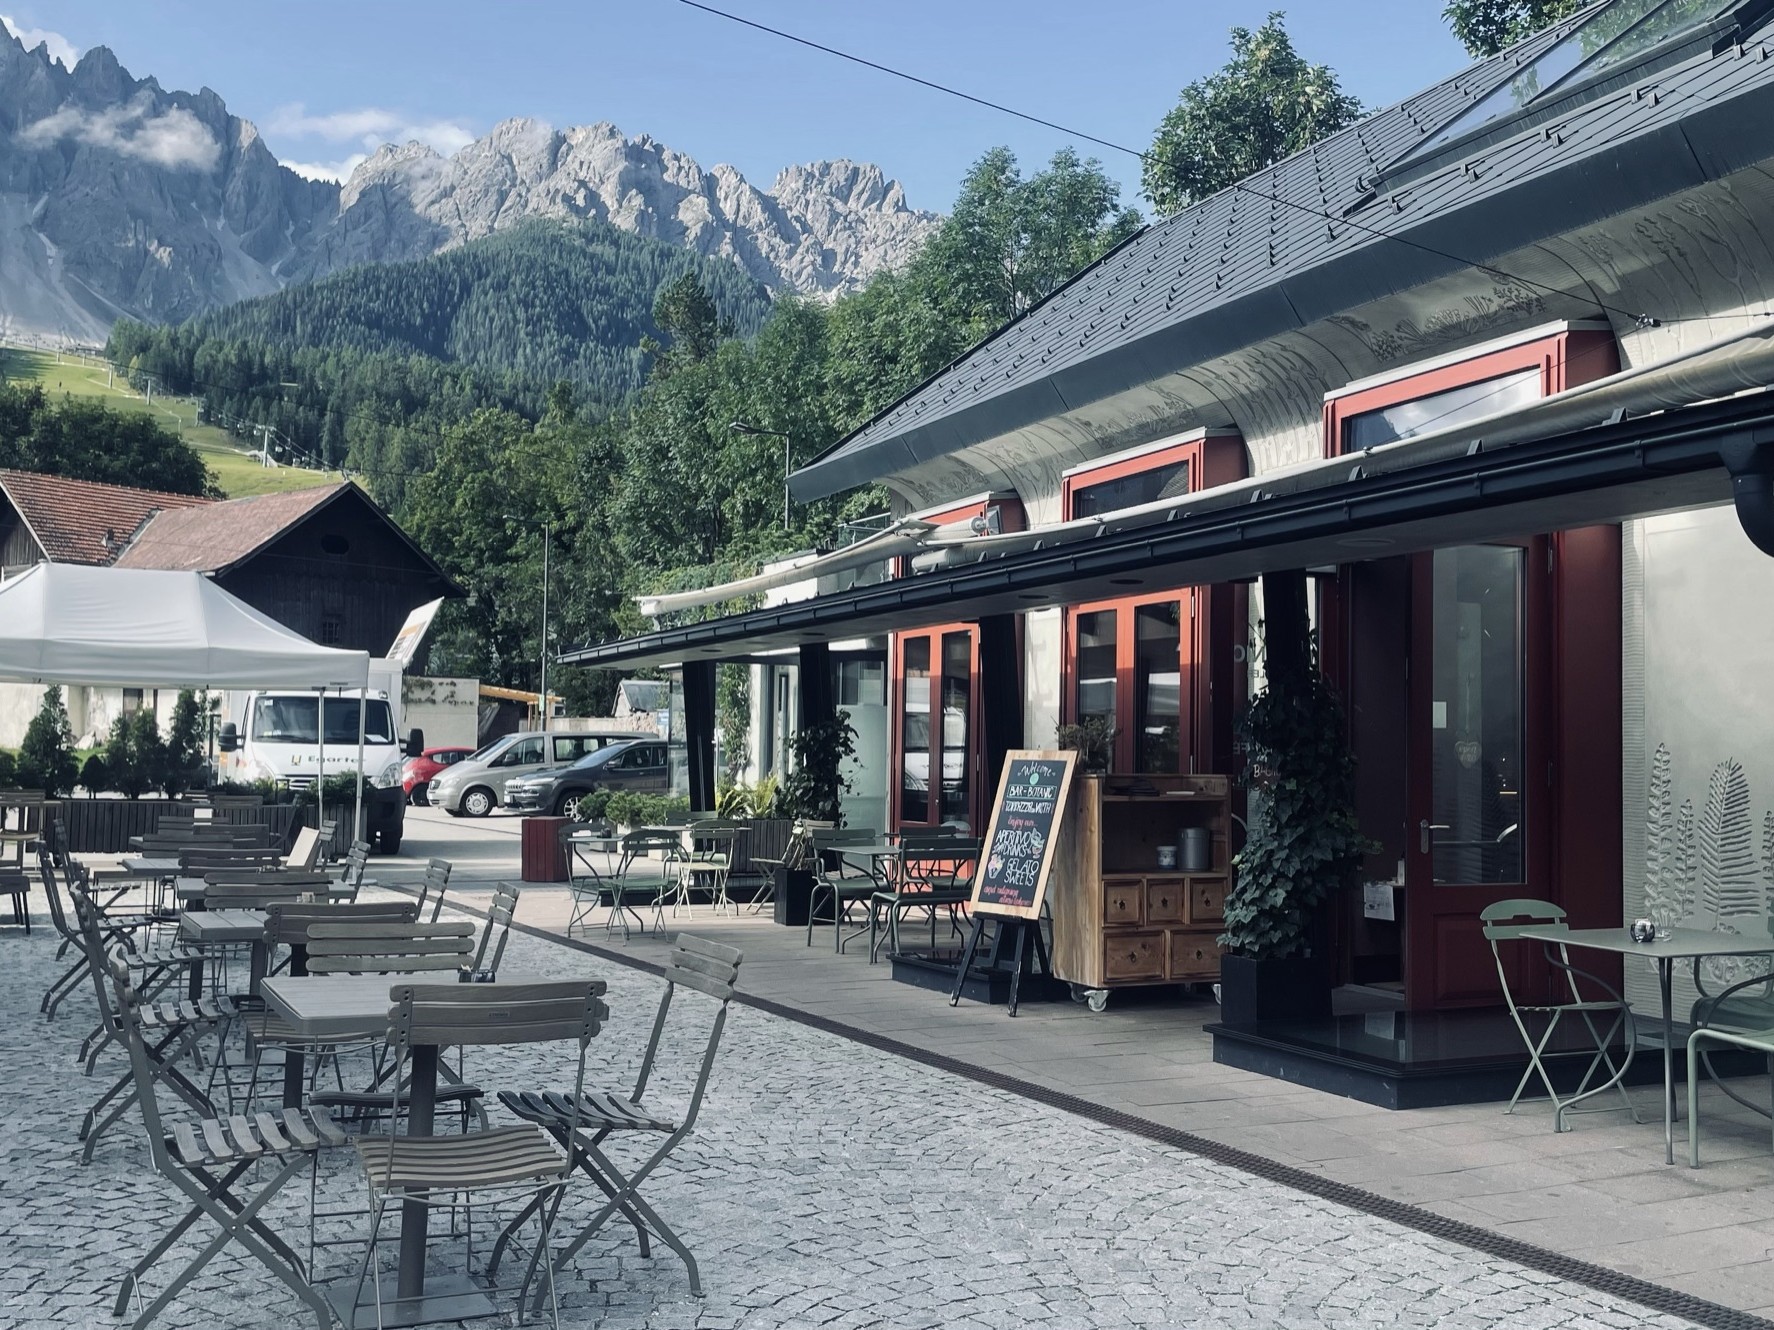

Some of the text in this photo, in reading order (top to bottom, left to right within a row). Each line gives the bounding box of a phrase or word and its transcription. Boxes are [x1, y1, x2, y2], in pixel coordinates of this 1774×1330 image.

[308, 756, 366, 764] Egarte
[1020, 761, 1052, 777] Welcome
[995, 829, 1031, 845] APERITIVO
[1006, 858, 1040, 873] GELATO
[1003, 870, 1034, 887] SWEETS
